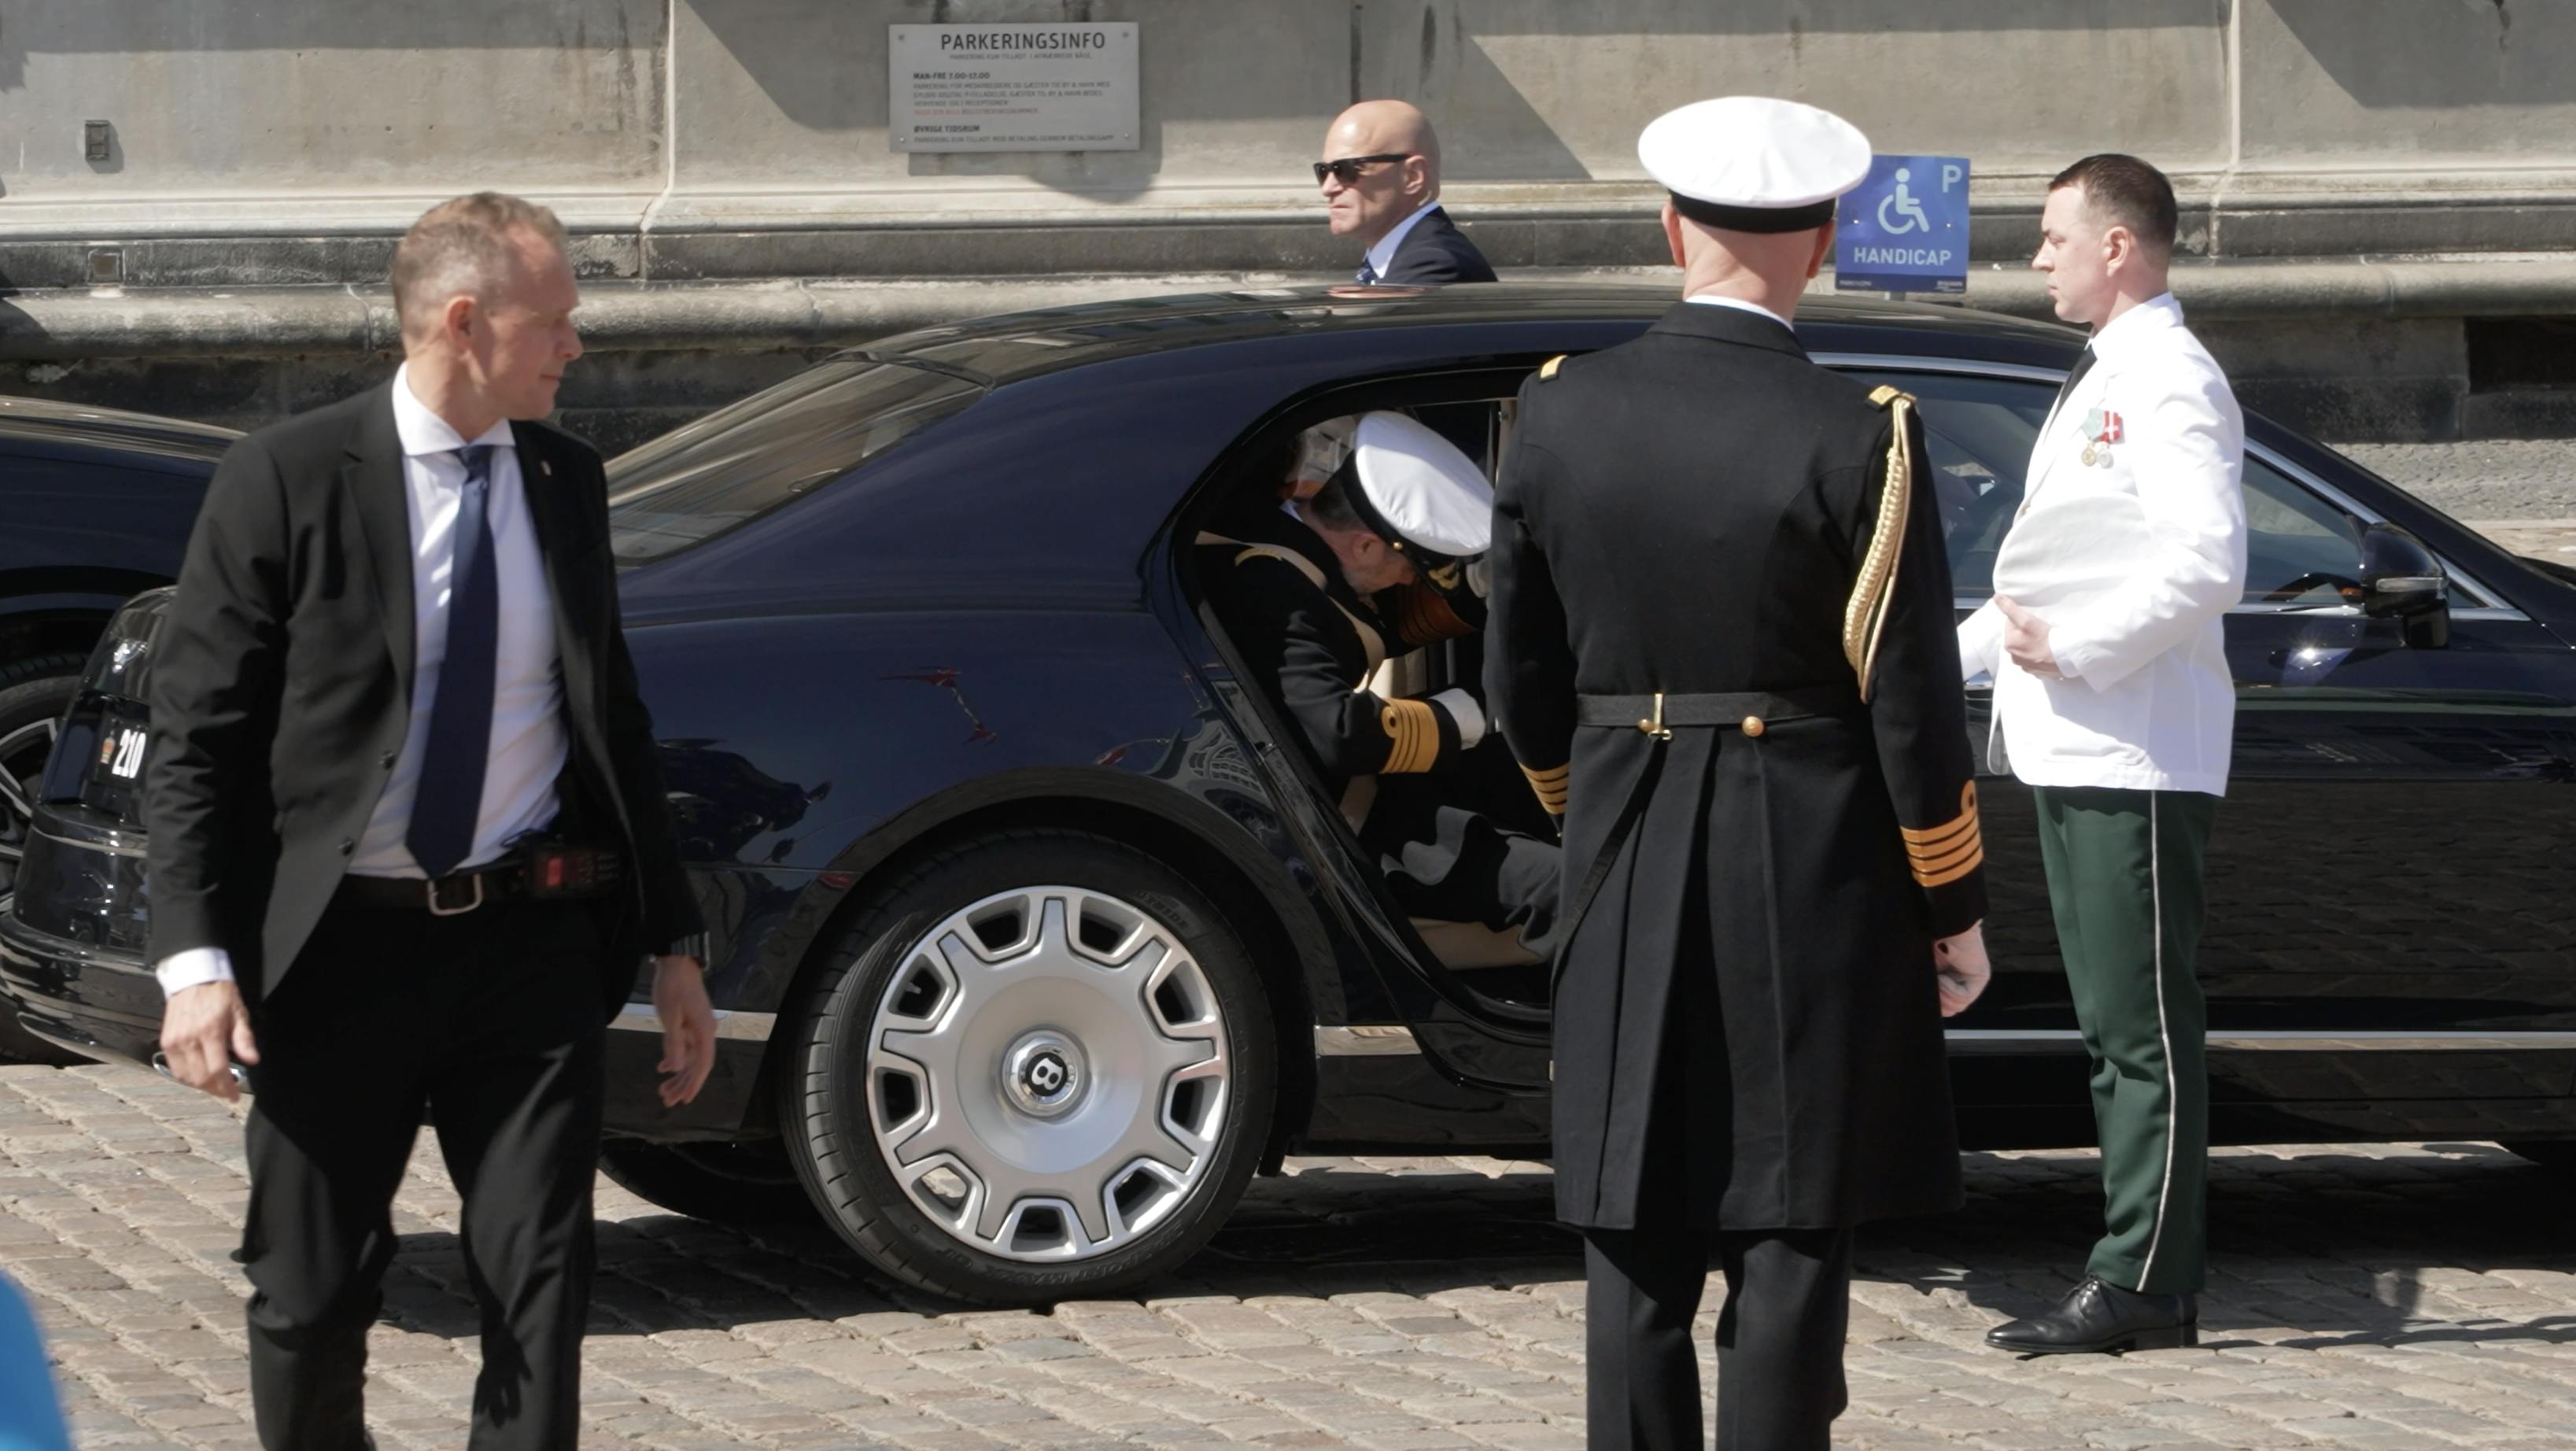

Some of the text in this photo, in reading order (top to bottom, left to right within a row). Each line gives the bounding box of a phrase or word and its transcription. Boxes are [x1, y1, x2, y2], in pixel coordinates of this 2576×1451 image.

[941, 32, 1105, 50] PARKERINGSINFO
[1942, 164, 1962, 194] P
[1853, 246, 1952, 266] HANDICAP
[112, 729, 146, 779] 210
